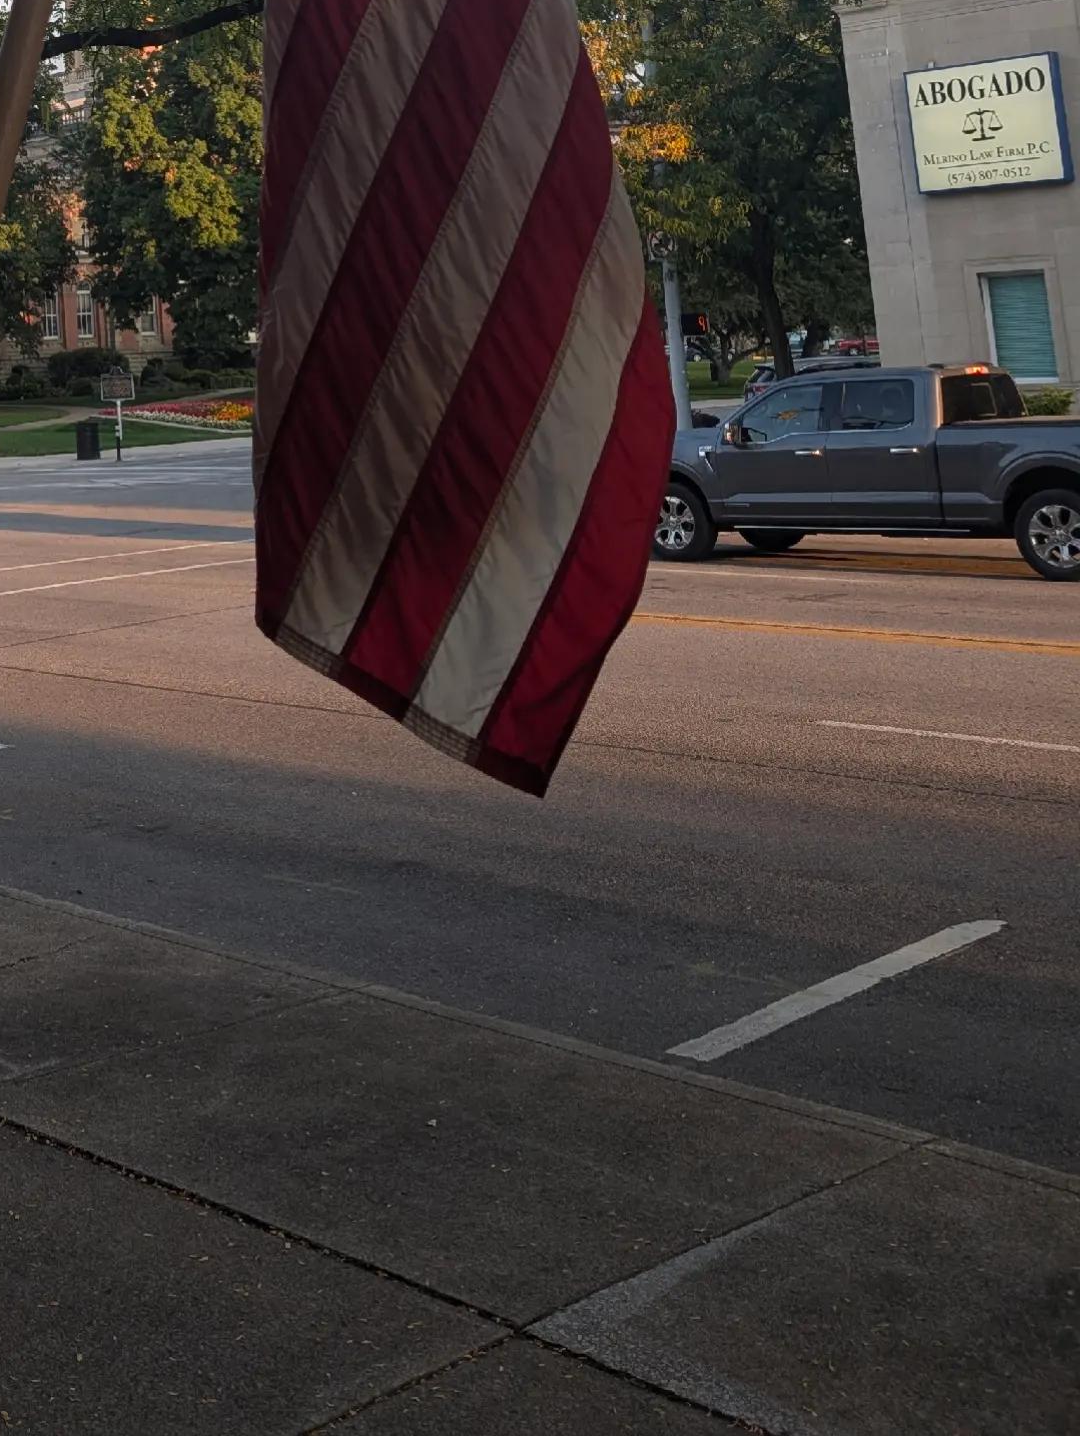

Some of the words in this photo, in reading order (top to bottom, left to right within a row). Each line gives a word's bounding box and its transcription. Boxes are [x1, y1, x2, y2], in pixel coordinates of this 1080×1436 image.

[914, 67, 1045, 107] ABOGADO
[947, 170, 977, 186] (574)
[979, 166, 1032, 181] 807-0512
